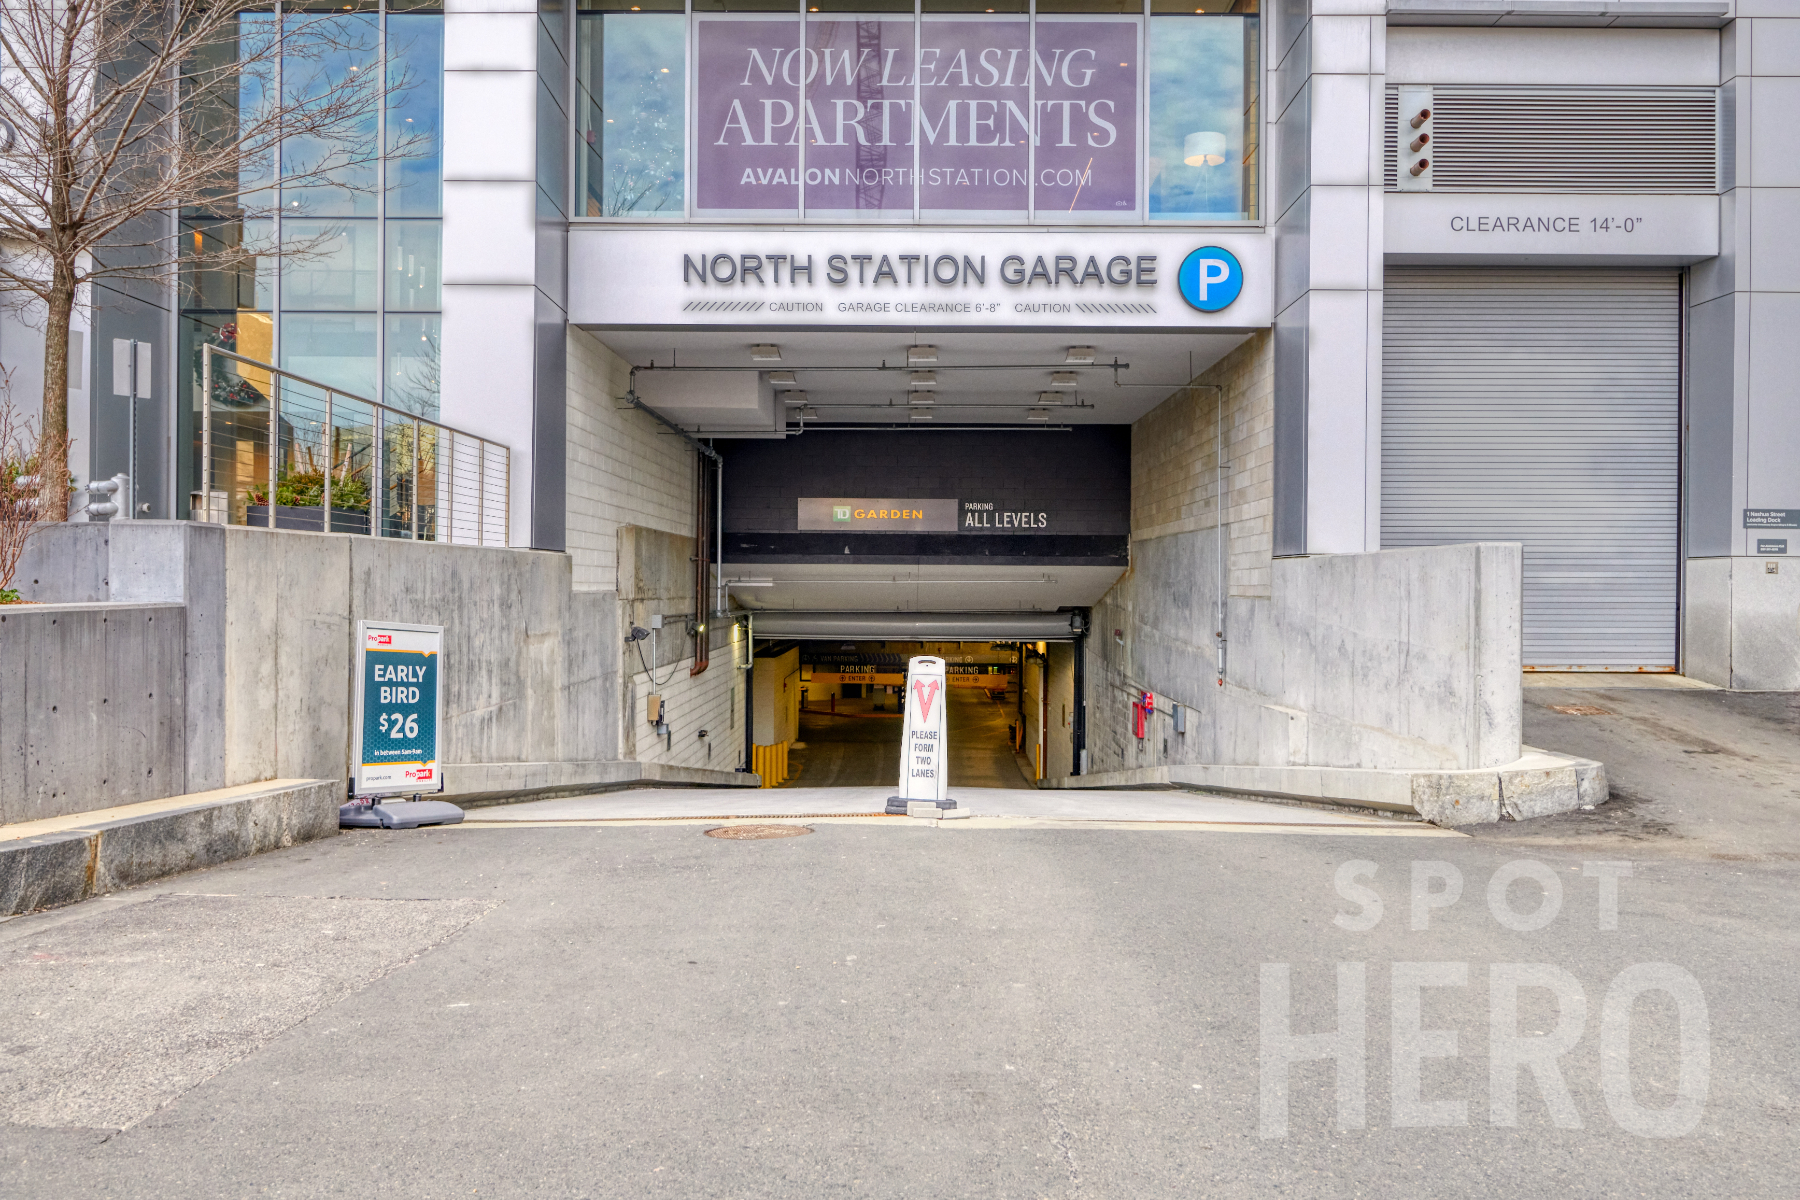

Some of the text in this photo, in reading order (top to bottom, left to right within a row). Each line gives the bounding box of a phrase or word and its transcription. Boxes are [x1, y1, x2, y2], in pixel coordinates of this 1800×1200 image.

[740, 47, 1096, 87] NOW LEASING
[713, 98, 1117, 147] APARTMENTS
[1450, 216, 1580, 233] CLEARANCE
[683, 253, 1158, 285] NORTH STATION GARAGE
[1199, 258, 1230, 301] P
[769, 302, 823, 312] CAUTION
[837, 302, 891, 313] GARAGE
[895, 302, 971, 313] CLEARANCE
[1014, 303, 1071, 313] CAUTION
[965, 502, 994, 511] PARKING
[834, 508, 923, 520] TD GARDEN
[965, 512, 1047, 527] ALL LEVELS
[374, 665, 427, 682] EARLY
[840, 665, 875, 674] PARKING
[380, 686, 420, 704] BIRD
[379, 712, 419, 739] $26
[911, 730, 938, 740] PLEASE
[914, 743, 934, 753] FORM
[915, 756, 932, 765] TWO
[405, 769, 433, 780] Propark
[911, 768, 935, 778] LANES
